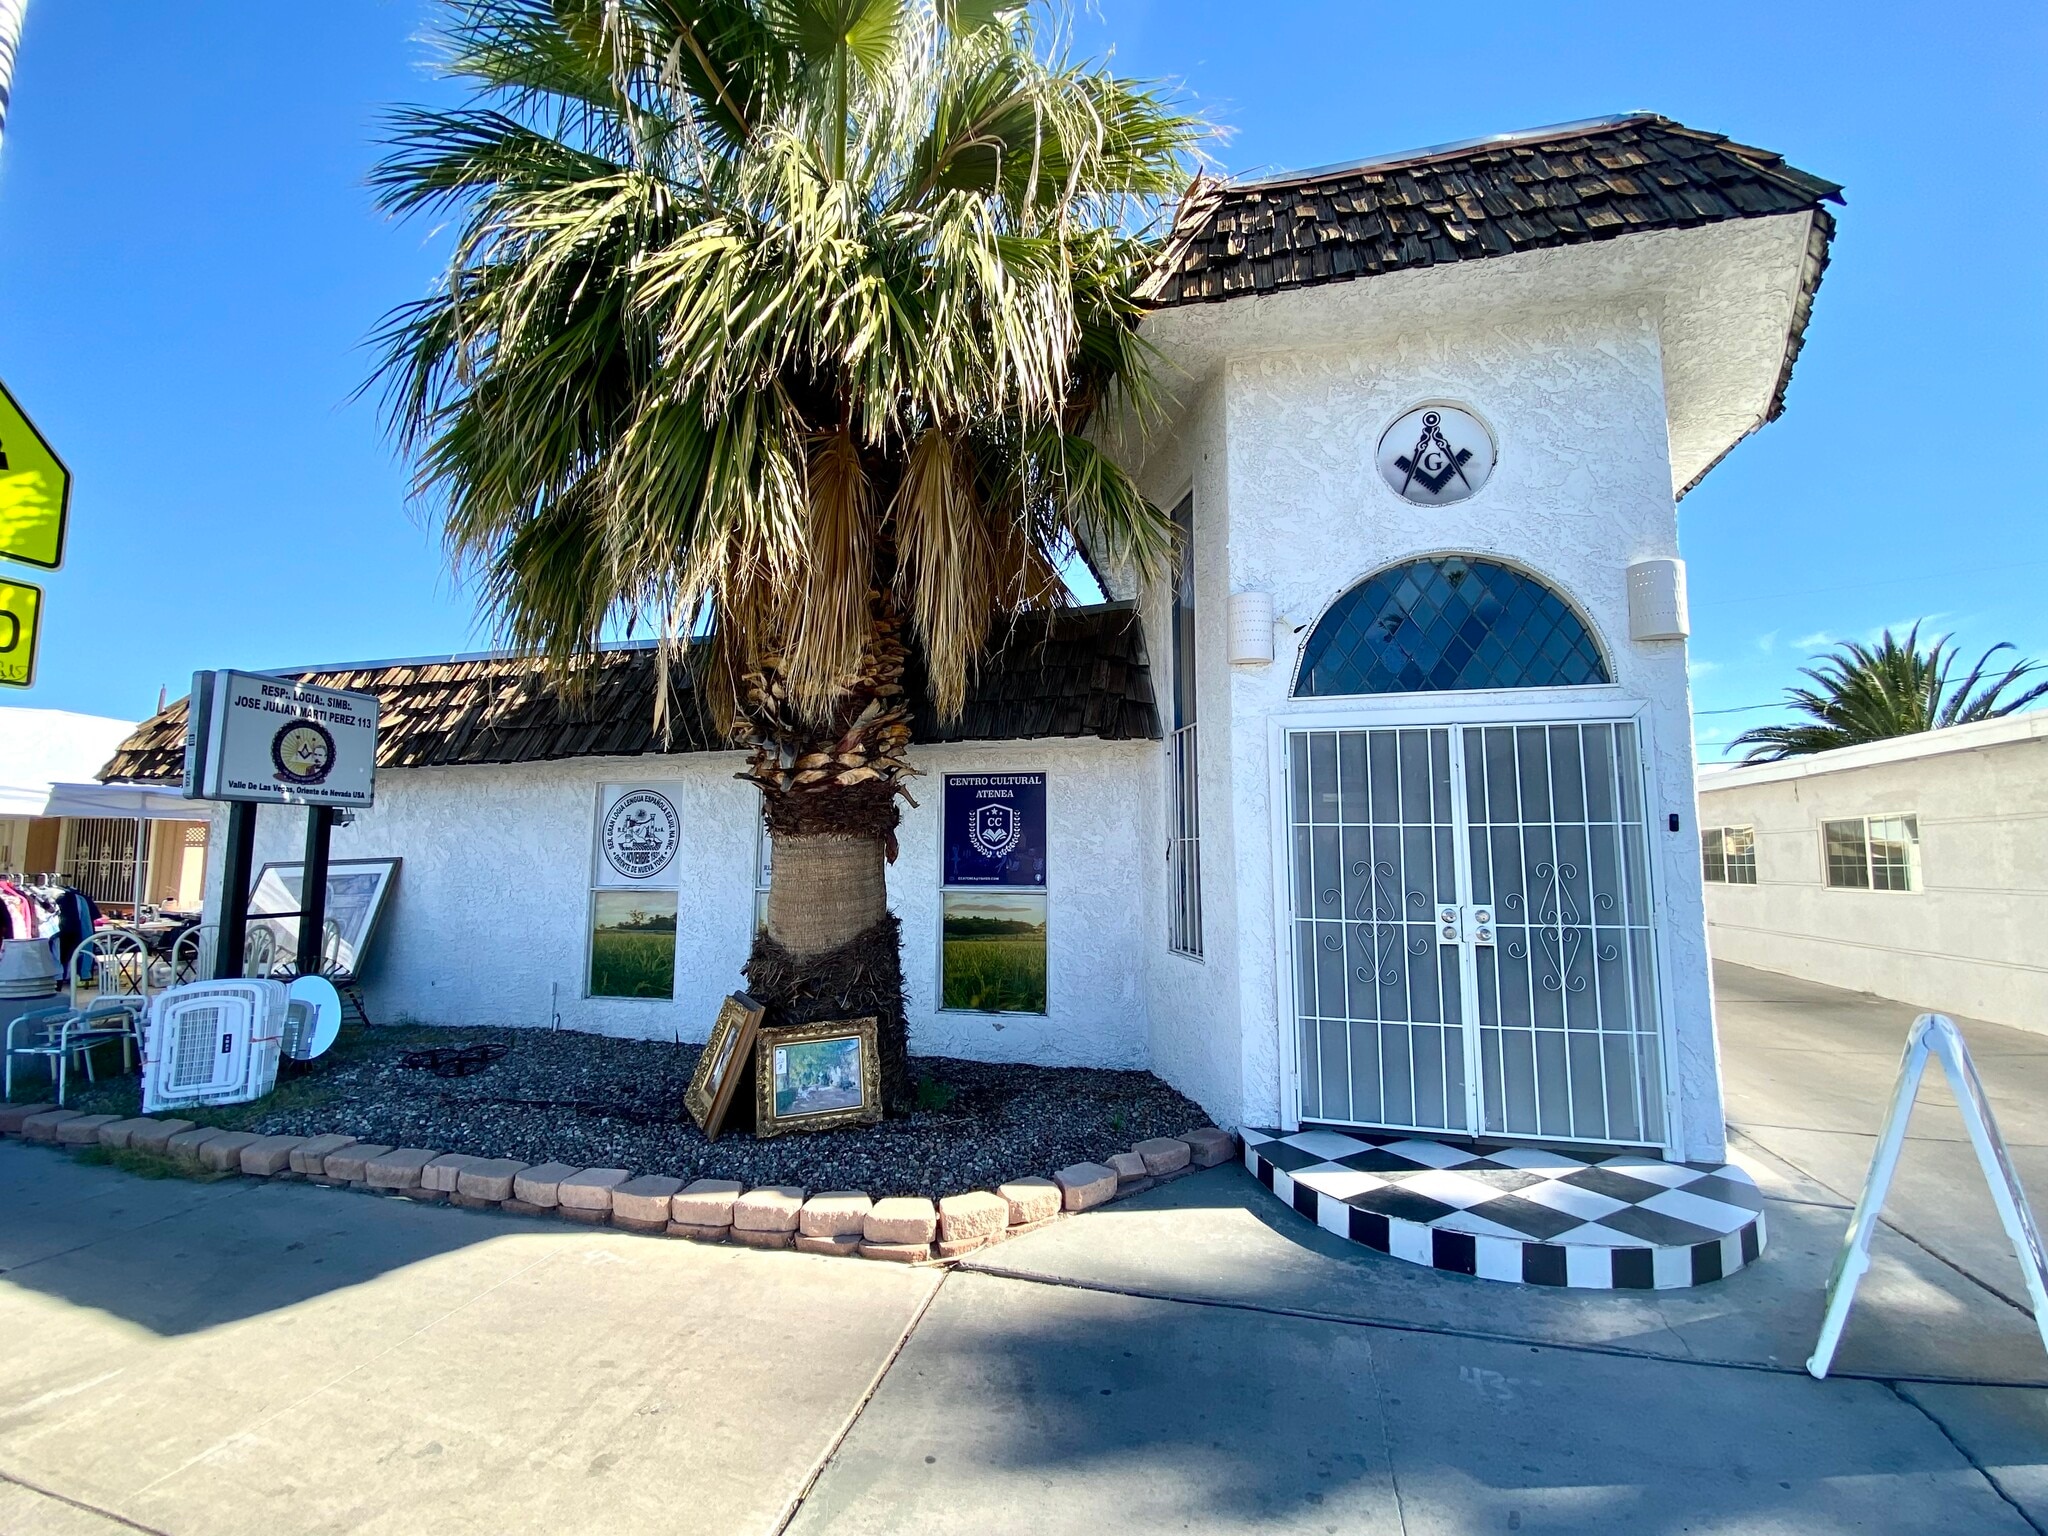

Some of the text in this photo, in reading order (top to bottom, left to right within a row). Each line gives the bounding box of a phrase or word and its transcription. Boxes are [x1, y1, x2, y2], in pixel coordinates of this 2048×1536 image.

[1424, 453, 1442, 471] G
[235, 696, 371, 728] JOSE JULIAN MARTI PEREZ 113
[229, 781, 246, 792] Valle
[248, 782, 257, 790] De
[259, 783, 271, 791] Las
[297, 787, 319, 796] Oriente
[330, 789, 351, 798] Nevada
[950, 777, 1041, 785] CENTRO CULTURAL
[976, 790, 1014, 798] ATENEA
[607, 820, 615, 836] GRAN
[613, 805, 625, 819] LOGIA
[624, 795, 644, 808] LENGUA
[645, 796, 668, 813] ESPAÑOLA
[987, 817, 1002, 826] CC
[614, 855, 630, 872] ORIENTE
[638, 864, 654, 873] NUEVA
[654, 855, 666, 868] YORK
